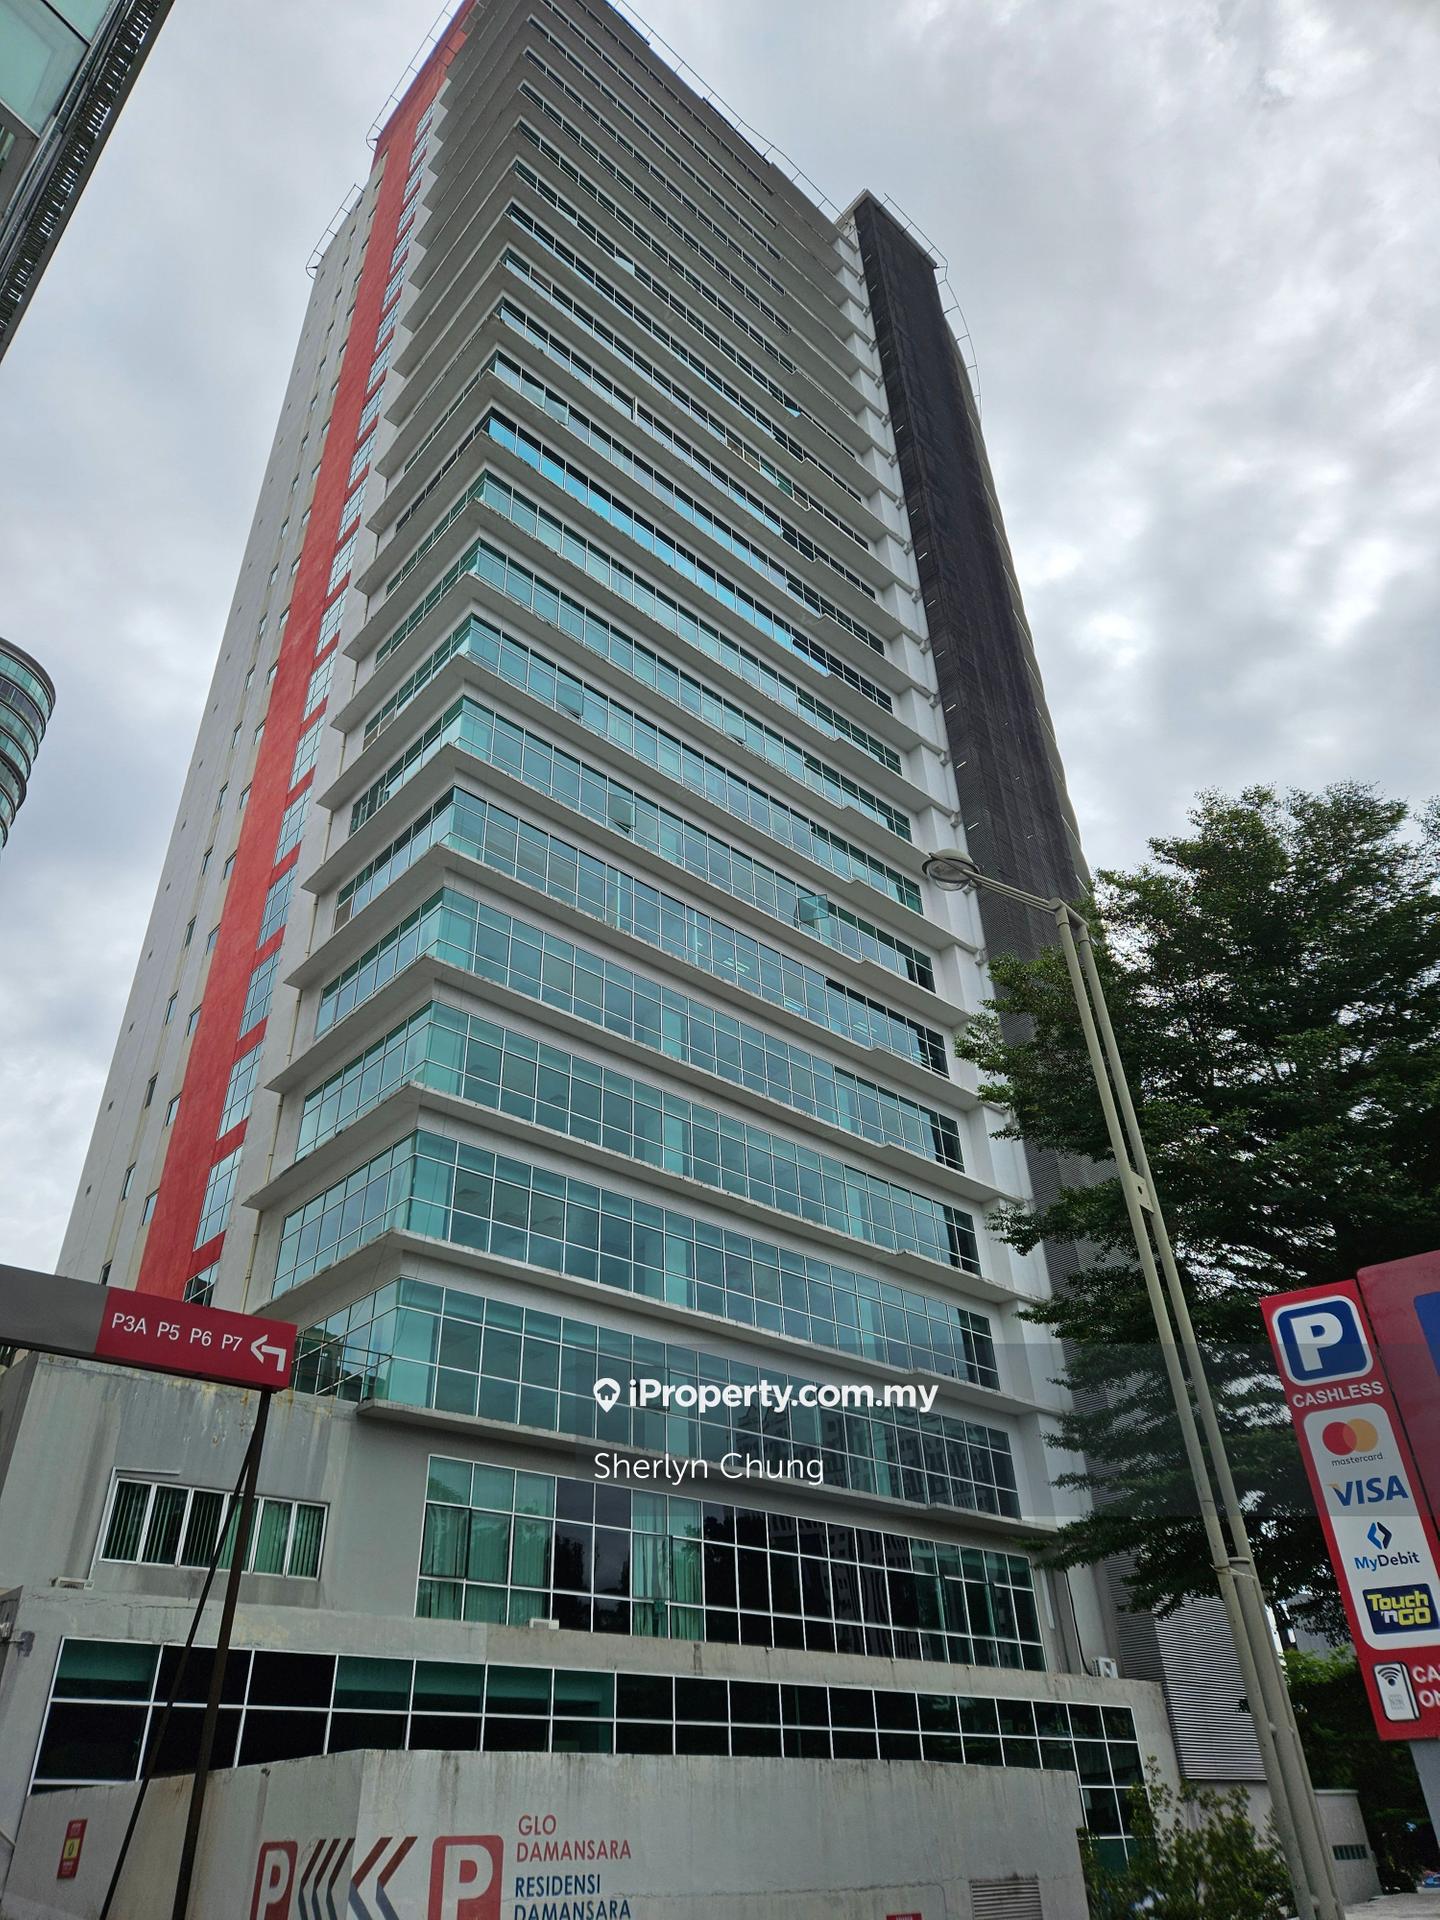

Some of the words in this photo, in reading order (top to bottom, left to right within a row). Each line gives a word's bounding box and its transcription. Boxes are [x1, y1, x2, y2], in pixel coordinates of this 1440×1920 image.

[111, 1312, 146, 1335] P3A
[156, 1321, 180, 1341] P5
[189, 1328, 212, 1347] P6
[221, 1333, 243, 1352] P7
[1290, 1312, 1343, 1371] P
[1292, 1381, 1385, 1408] CASHLESS
[1331, 1452, 1384, 1467] mastercard
[1328, 1475, 1409, 1507] VISA
[1354, 1552, 1420, 1571] MyDebit
[1367, 1591, 1429, 1611] Touch
[518, 1814, 557, 1836] GLO
[516, 1840, 632, 1863] DAMANSARA
[257, 1849, 291, 1920] P
[440, 1844, 493, 1920] P
[515, 1874, 601, 1898] RESIDENSI
[514, 1899, 632, 1920] DAMANSARA
